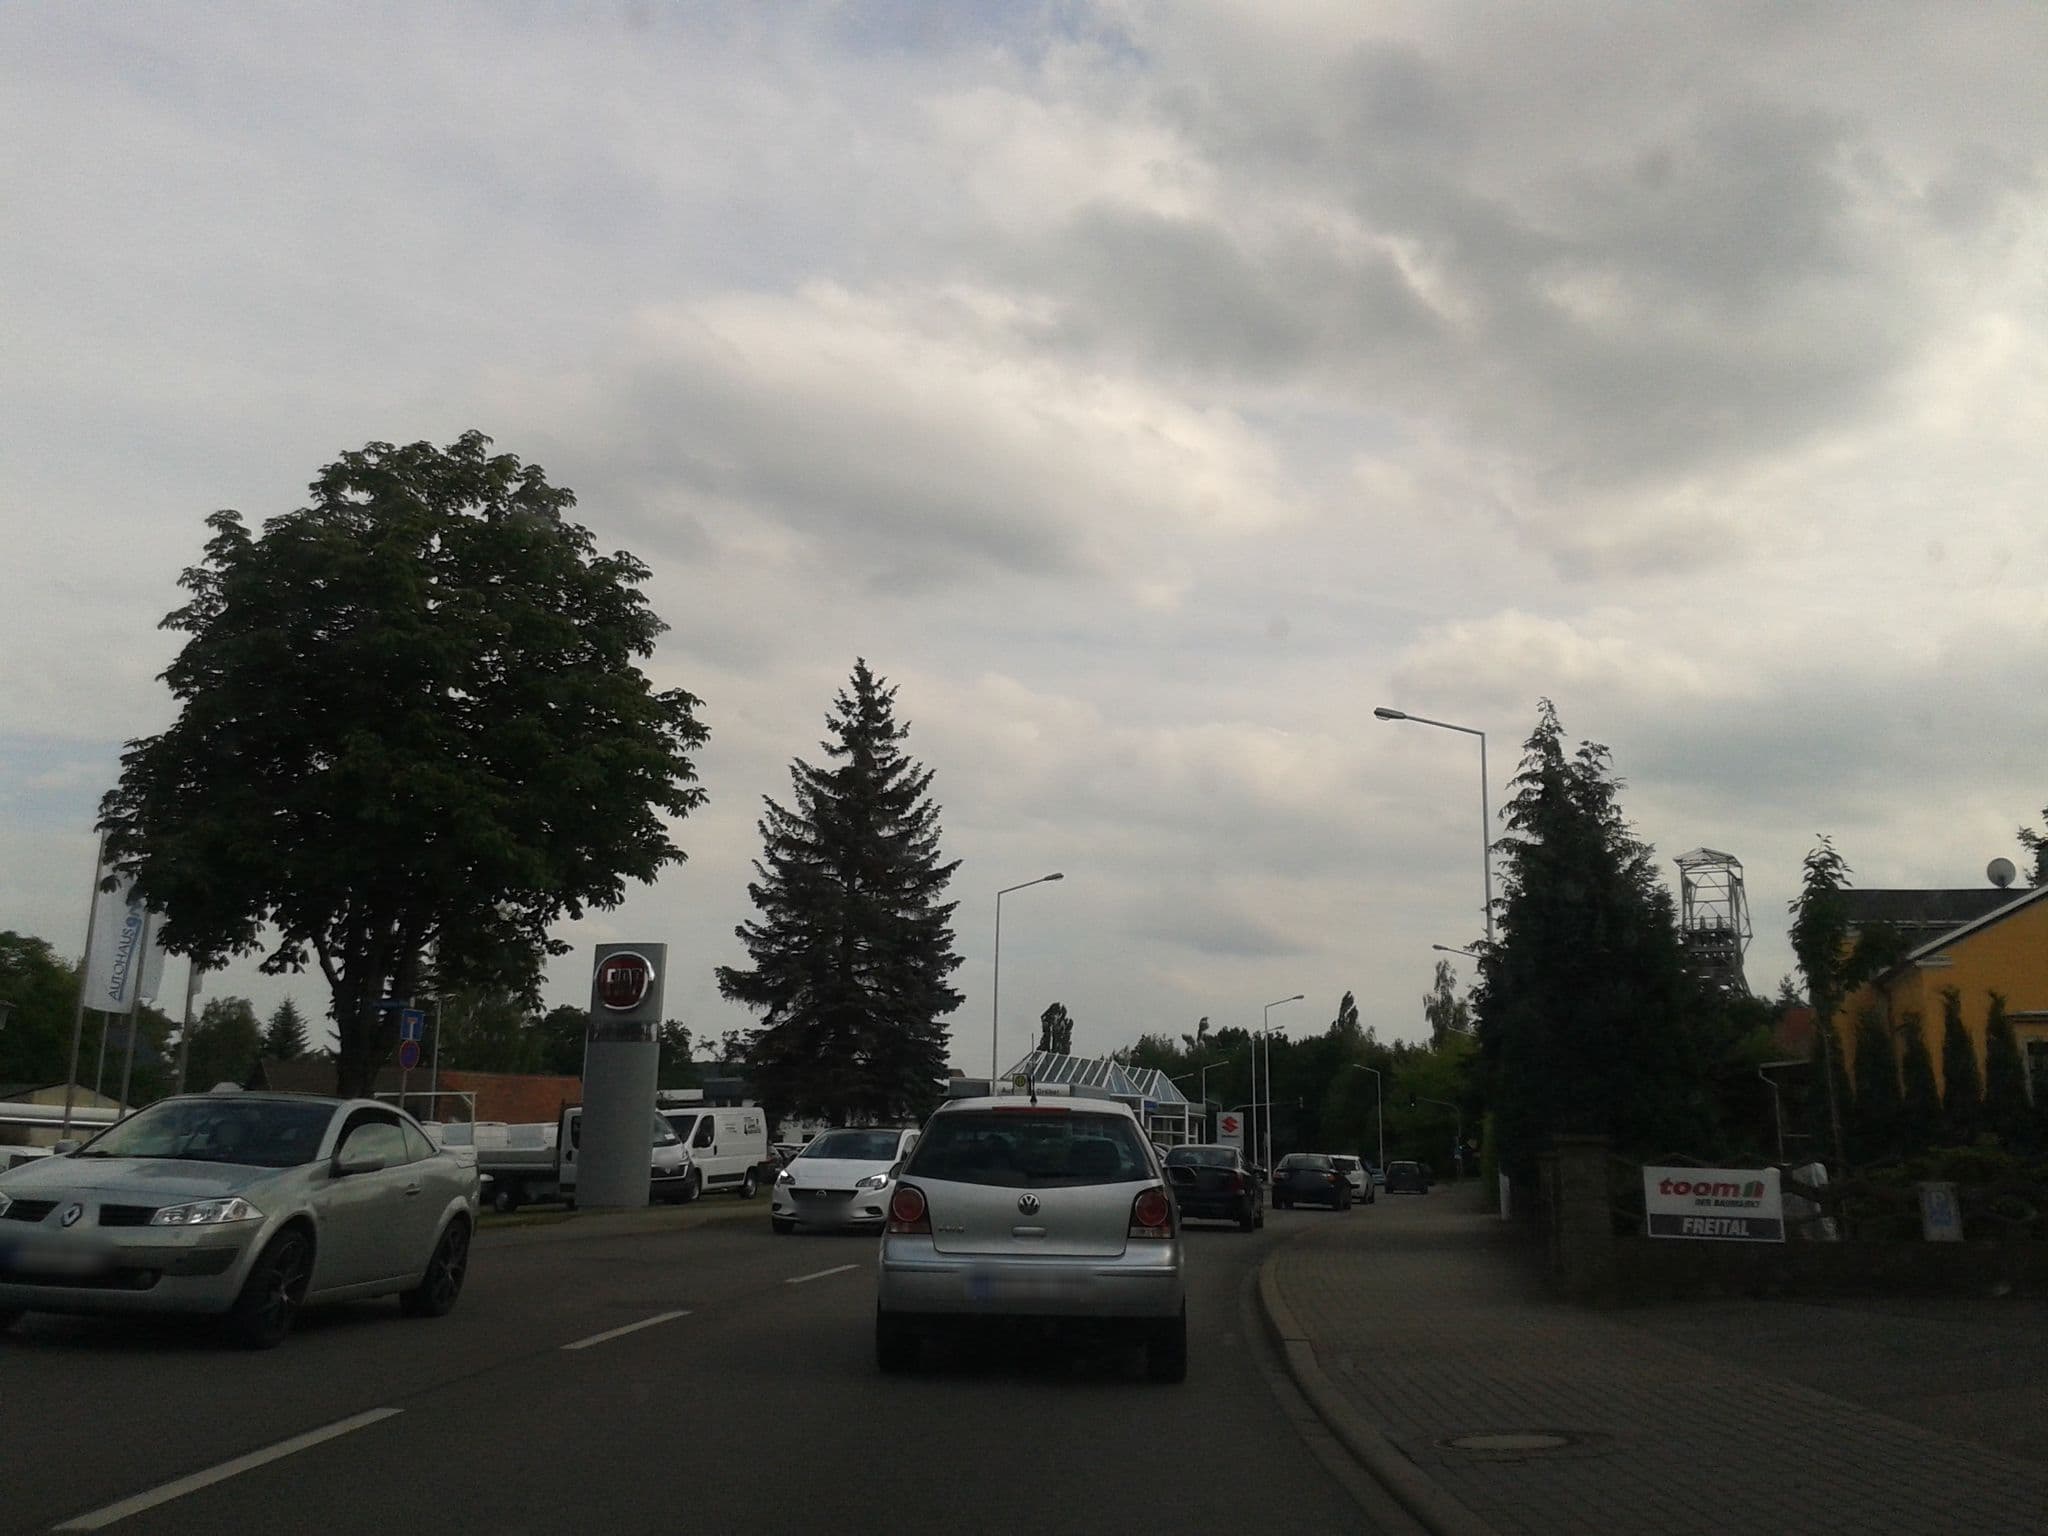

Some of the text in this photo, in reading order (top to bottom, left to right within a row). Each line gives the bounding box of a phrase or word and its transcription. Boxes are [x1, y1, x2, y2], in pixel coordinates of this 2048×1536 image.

[108, 928, 134, 1001] AUTOHAUS
[1659, 1177, 1741, 1198] toom
[1683, 1217, 1750, 1236] FREITAL
